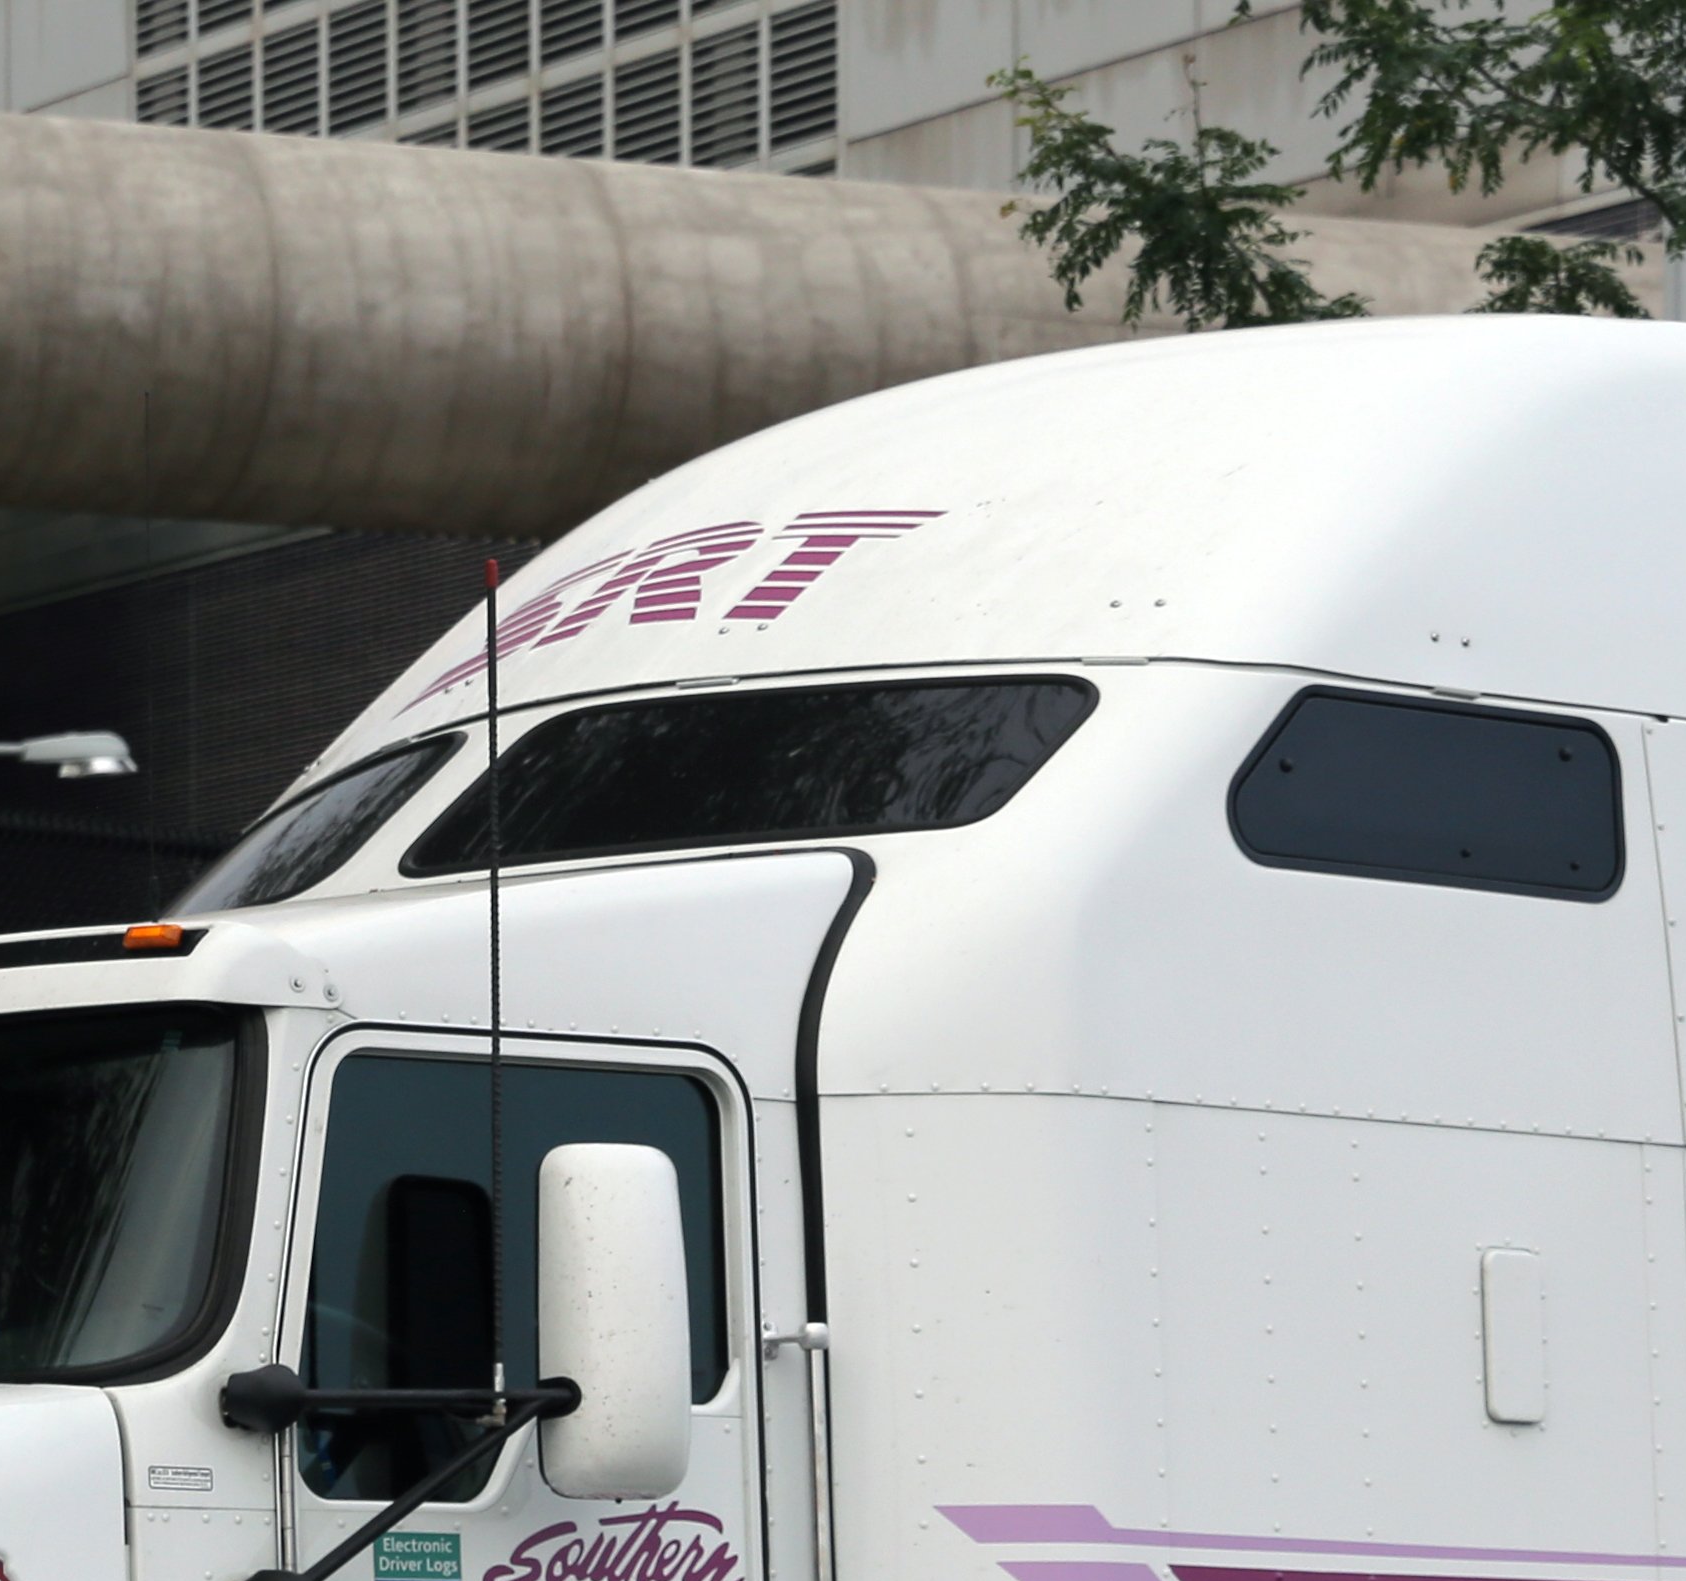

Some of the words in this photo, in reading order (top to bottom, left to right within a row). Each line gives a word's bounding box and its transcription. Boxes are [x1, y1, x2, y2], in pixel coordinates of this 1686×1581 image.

[394, 510, 948, 719] SRT
[383, 1537, 453, 1553] Electronic
[379, 1556, 422, 1572] Driver
[426, 1558, 458, 1577] Logs
